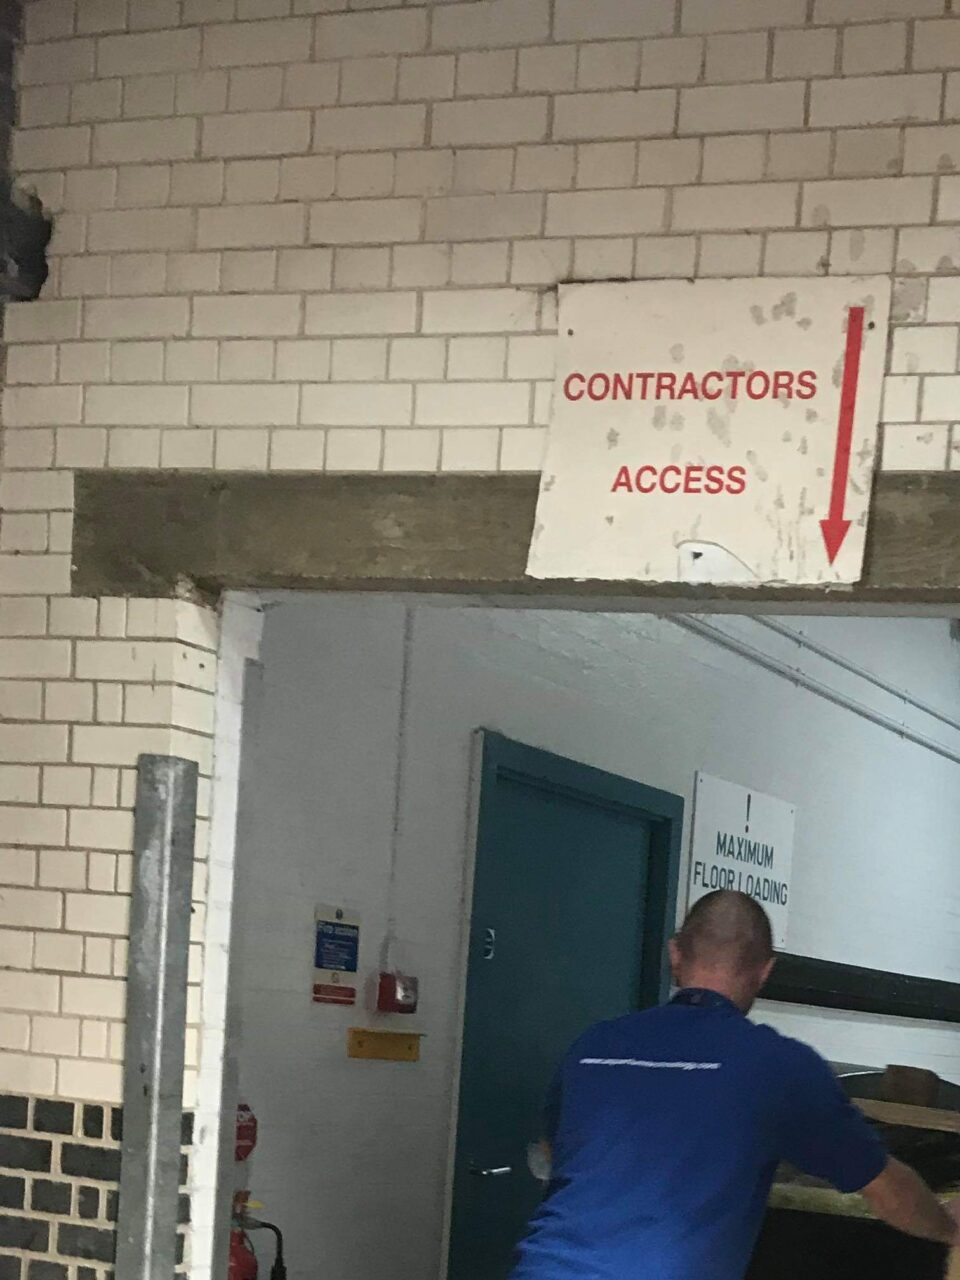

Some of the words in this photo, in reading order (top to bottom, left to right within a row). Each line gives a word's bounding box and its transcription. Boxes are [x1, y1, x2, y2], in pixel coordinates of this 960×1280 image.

[562, 370, 818, 402] CONTRACTORS
[610, 465, 747, 495] ACCESS
[715, 831, 774, 869] MAXIMUM
[693, 861, 735, 890] FLOOR
[738, 871, 788, 906] LOADING
